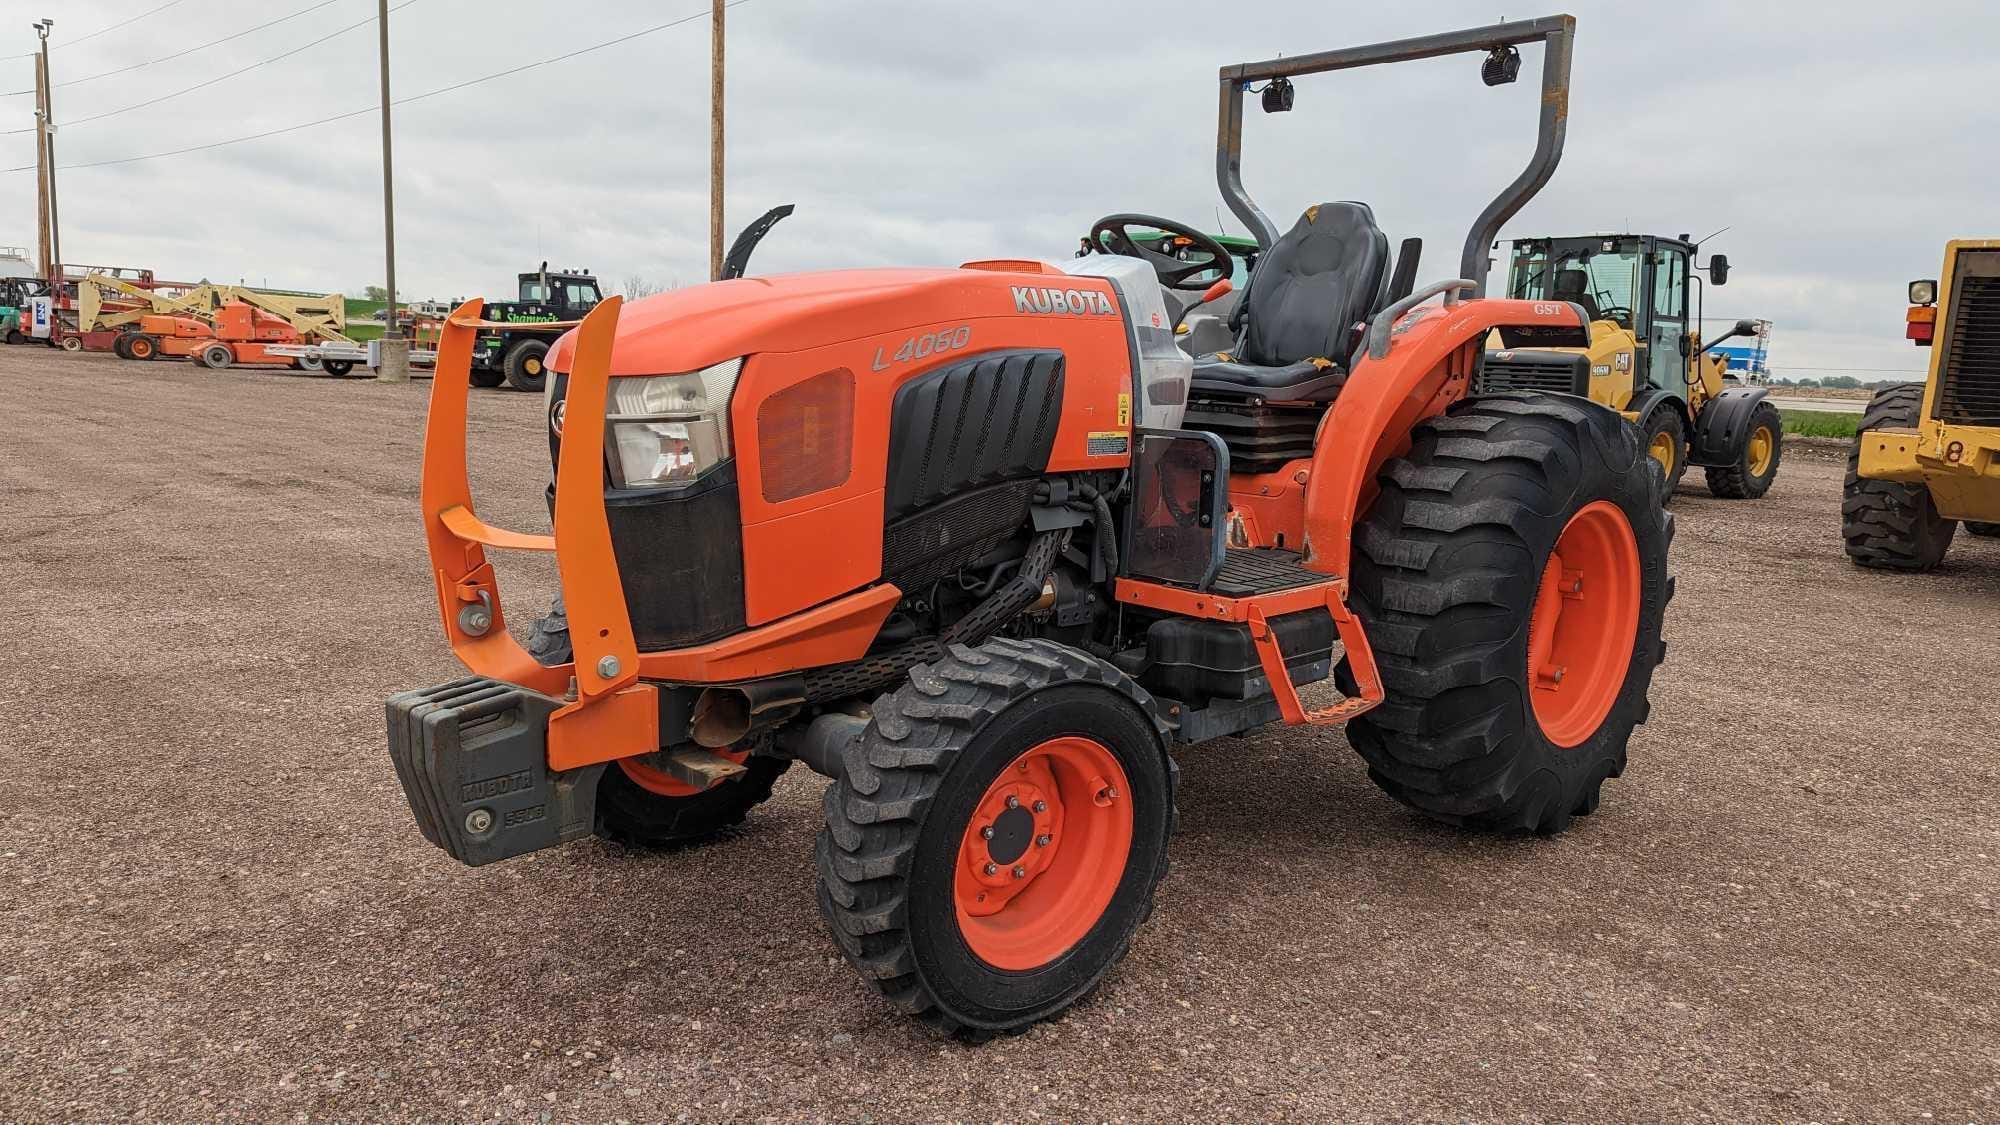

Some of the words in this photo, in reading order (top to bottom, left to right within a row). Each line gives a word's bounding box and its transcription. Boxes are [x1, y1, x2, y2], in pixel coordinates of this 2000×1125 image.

[1011, 286, 1116, 315] KUBOTA
[1534, 304, 1562, 315] GST
[1615, 352, 1629, 371] CAT
[1946, 440, 1964, 463] 8
[463, 772, 532, 802] KUBOTA
